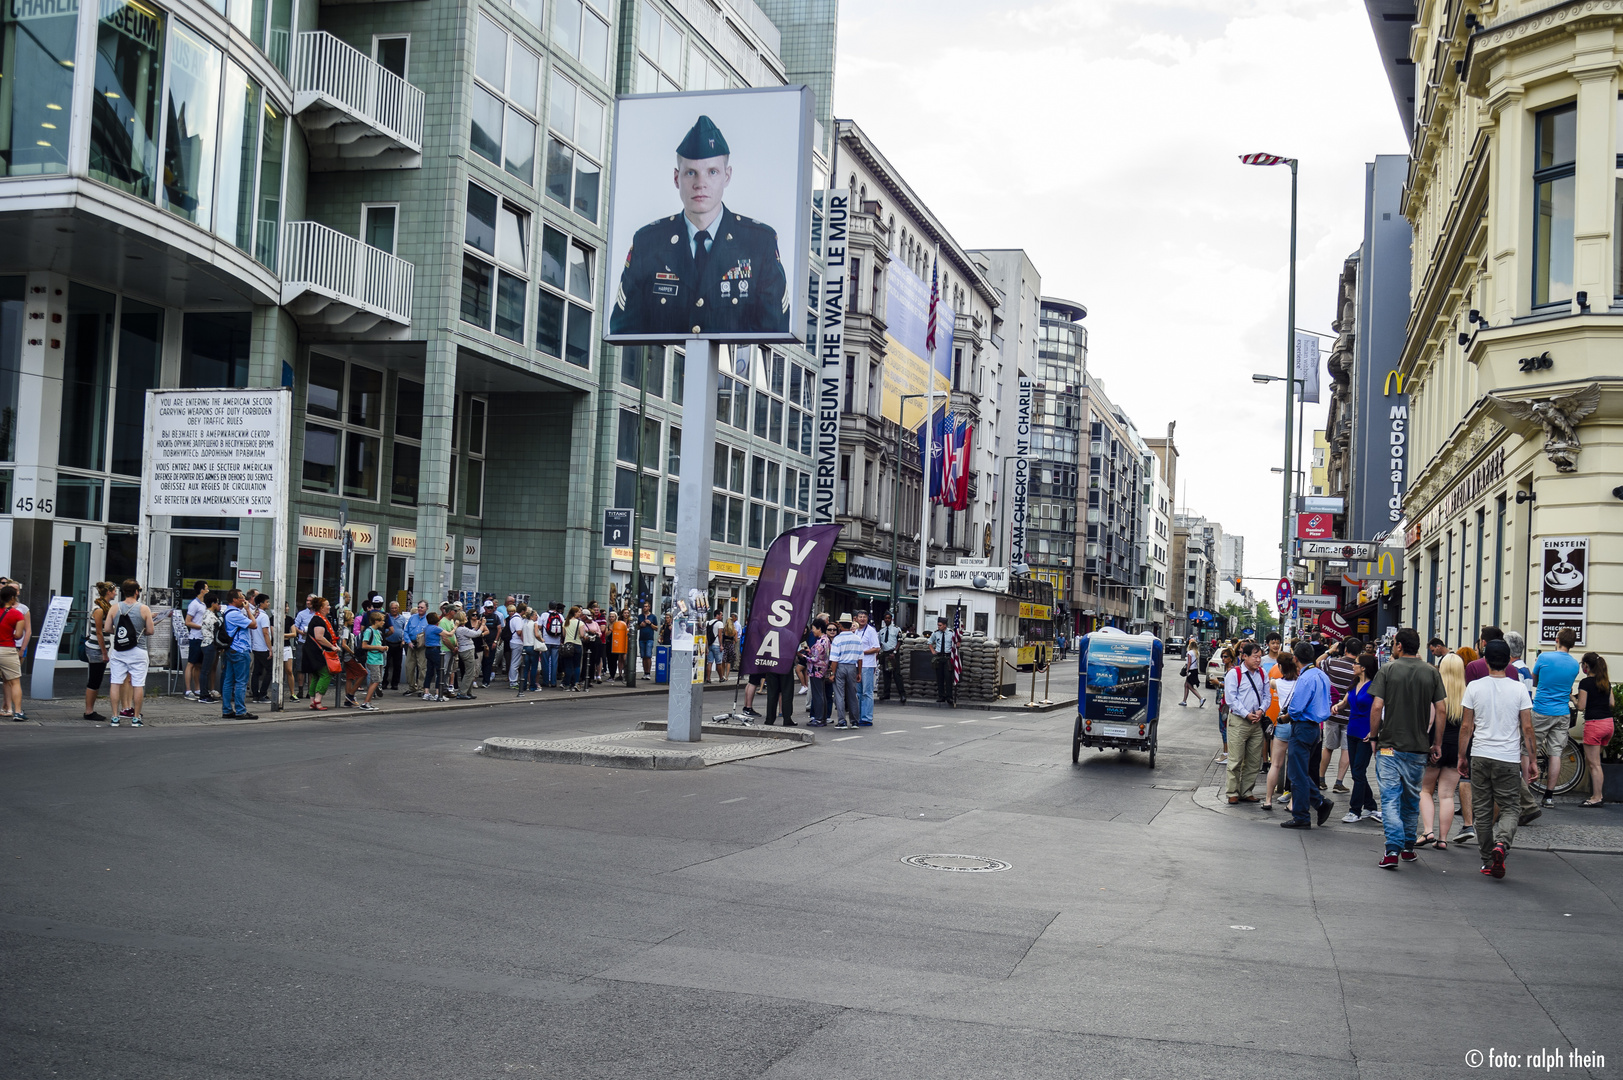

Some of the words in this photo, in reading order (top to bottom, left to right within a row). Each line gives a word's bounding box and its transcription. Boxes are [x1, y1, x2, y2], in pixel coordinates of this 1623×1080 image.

[828, 195, 848, 245] MUR
[828, 246, 845, 266] LE
[825, 275, 844, 328] WALL
[822, 333, 840, 368] THE
[1518, 351, 1553, 372] 206
[160, 398, 171, 406] YOU
[173, 398, 184, 406] ARE
[186, 398, 210, 406] ENTERING
[212, 398, 221, 406] THE
[223, 398, 250, 406] AMERICAN
[252, 398, 273, 406] SECTOR
[1018, 381, 1031, 435] CHARLIE
[215, 407, 224, 415] OFF
[227, 407, 240, 415] DUTY
[187, 417, 201, 425] OBEY
[204, 417, 224, 425] TRAFFIC
[162, 430, 170, 438] ВЫ
[200, 430, 204, 438] В
[206, 429, 249, 438] АМЕРИКАНСКИЙ
[220, 440, 224, 448] В
[258, 440, 274, 448] ВРЕМЯ
[236, 449, 266, 457] ПРАВИЛАМ
[156, 463, 169, 471] VOUS
[172, 463, 190, 471] ENTREZ
[192, 463, 207, 471] DANS
[209, 463, 214, 471] LE
[216, 463, 240, 471] SECTEUR
[1389, 405, 1407, 522] McDonalds
[1013, 438, 1029, 522] CHECKPOINT
[16, 497, 33, 512] 45
[37, 498, 53, 513] 45
[154, 496, 162, 504] SIE
[164, 496, 189, 504] BETRETEN
[191, 496, 201, 504] DEN
[203, 496, 249, 504] AMERIKANISCHEN
[251, 496, 272, 504] SEKTOR
[302, 525, 357, 542] MAUERMUSM
[849, 562, 877, 582] CHECKPOINT
[877, 566, 892, 583] CHARL
[938, 570, 948, 579] US
[950, 570, 968, 580] ARMY
[756, 535, 818, 659] VISA
[754, 658, 779, 667] STAMP
